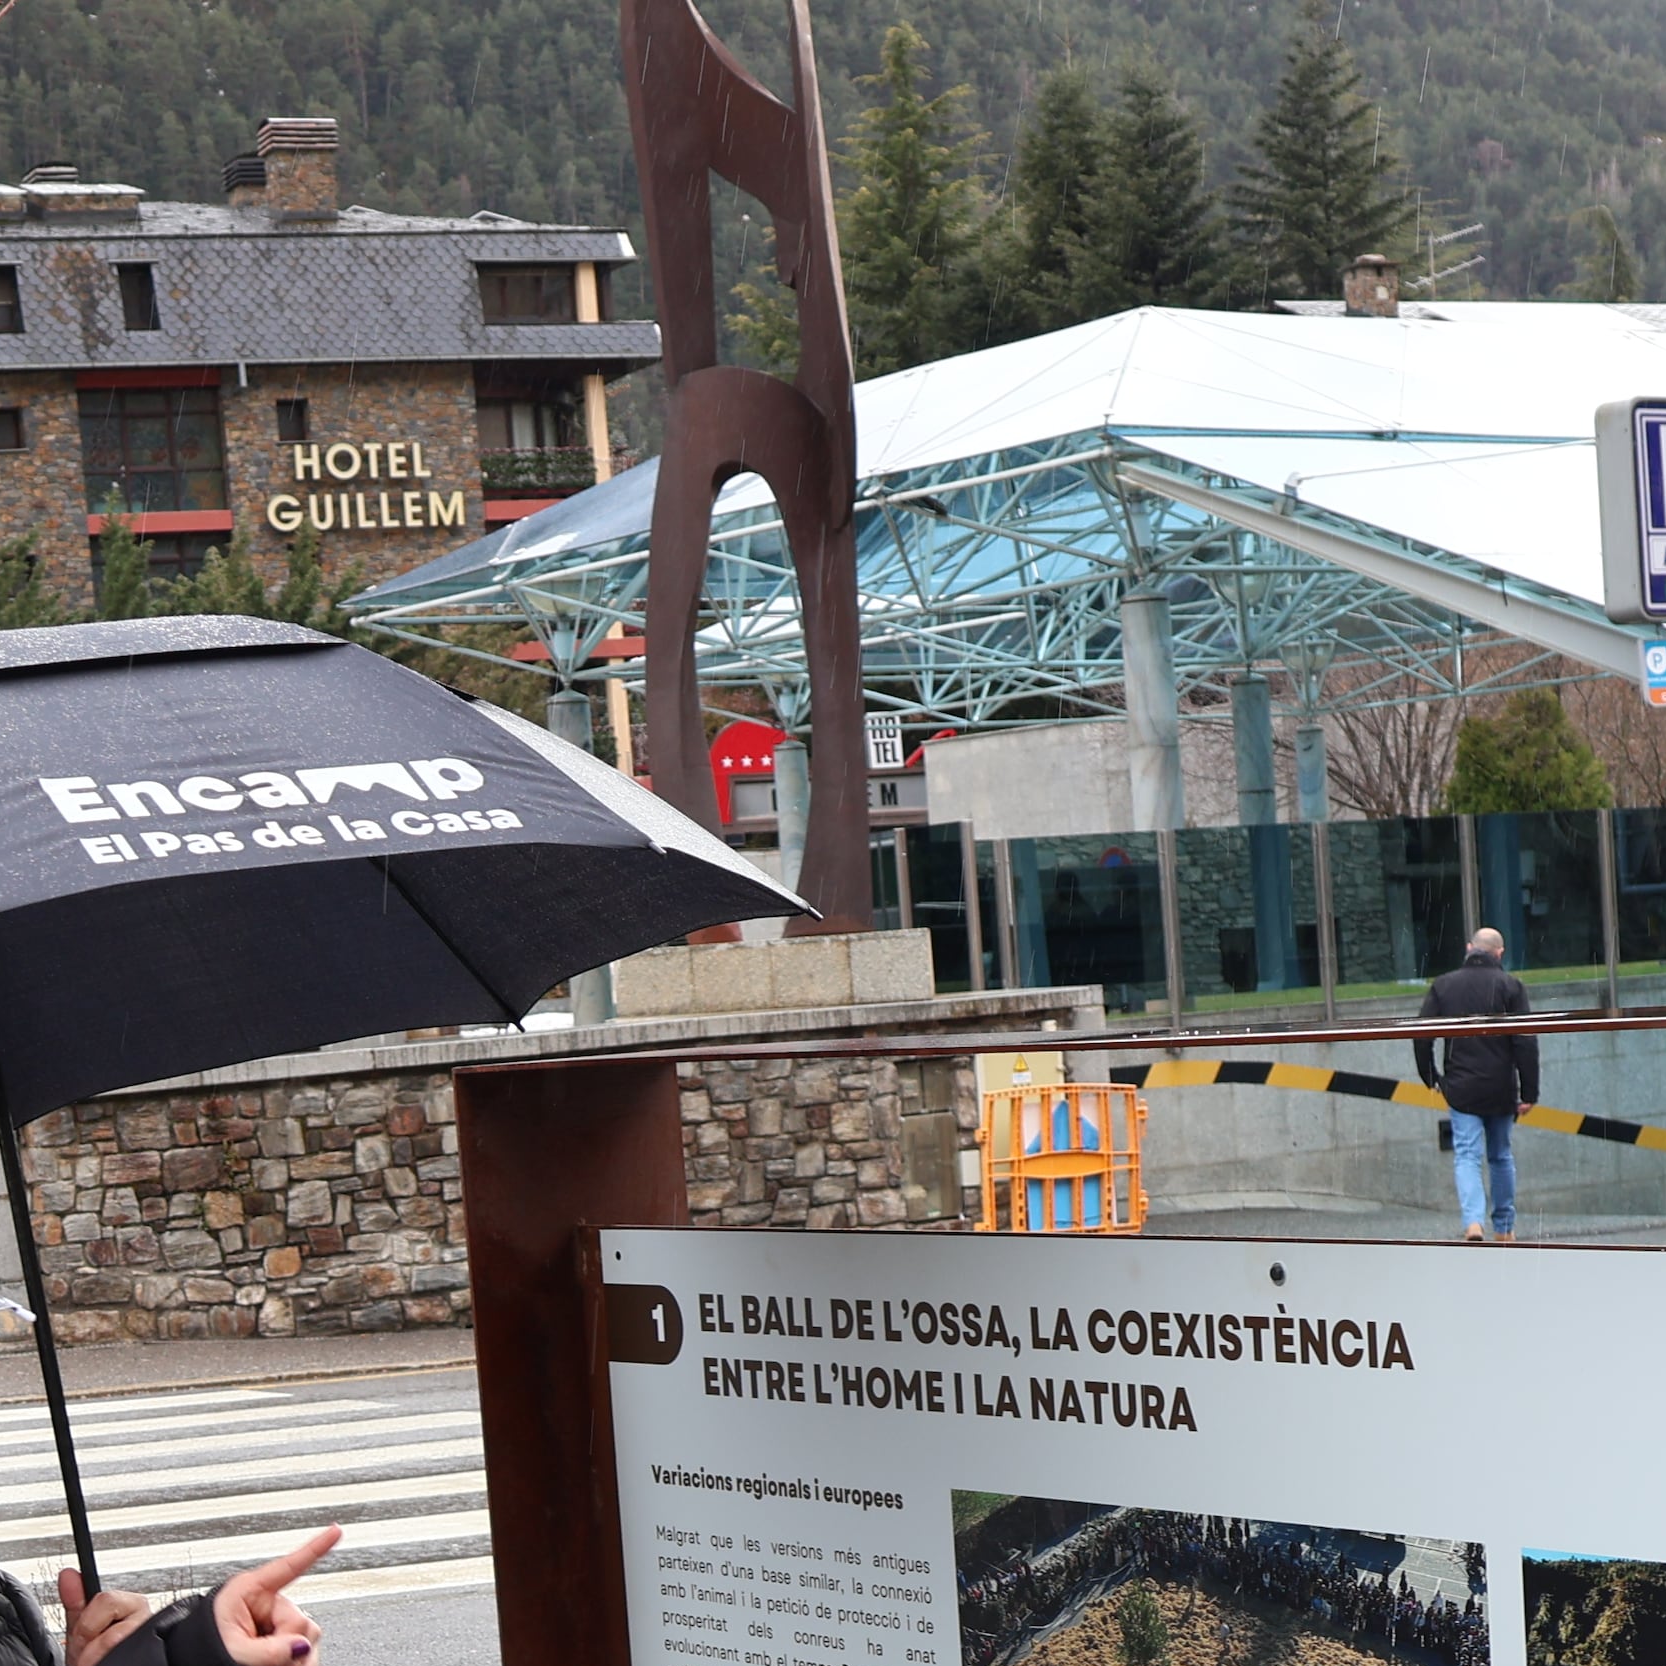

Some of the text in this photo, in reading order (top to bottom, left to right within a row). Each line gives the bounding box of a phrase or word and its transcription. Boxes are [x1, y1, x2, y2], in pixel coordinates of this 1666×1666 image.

[294, 442, 431, 480] HOTEL
[267, 491, 466, 531] GUILLEM
[873, 741, 900, 763] TEL
[38, 757, 484, 823] Encamp
[79, 808, 523, 865] El Pas de la Casa
[652, 1304, 665, 1342] 1
[698, 1293, 1415, 1370] EL BALL DE L'OSSA, LA COEXISTÈNCIA
[703, 1357, 1198, 1432] ENTRE L'HOME I LA NATURA
[651, 1464, 903, 1511] Variacions regionals i europees
[656, 1525, 930, 1575] Malgrat que les versions més antigues
[659, 1556, 932, 1604] parteixen d'una base similar, la connexió
